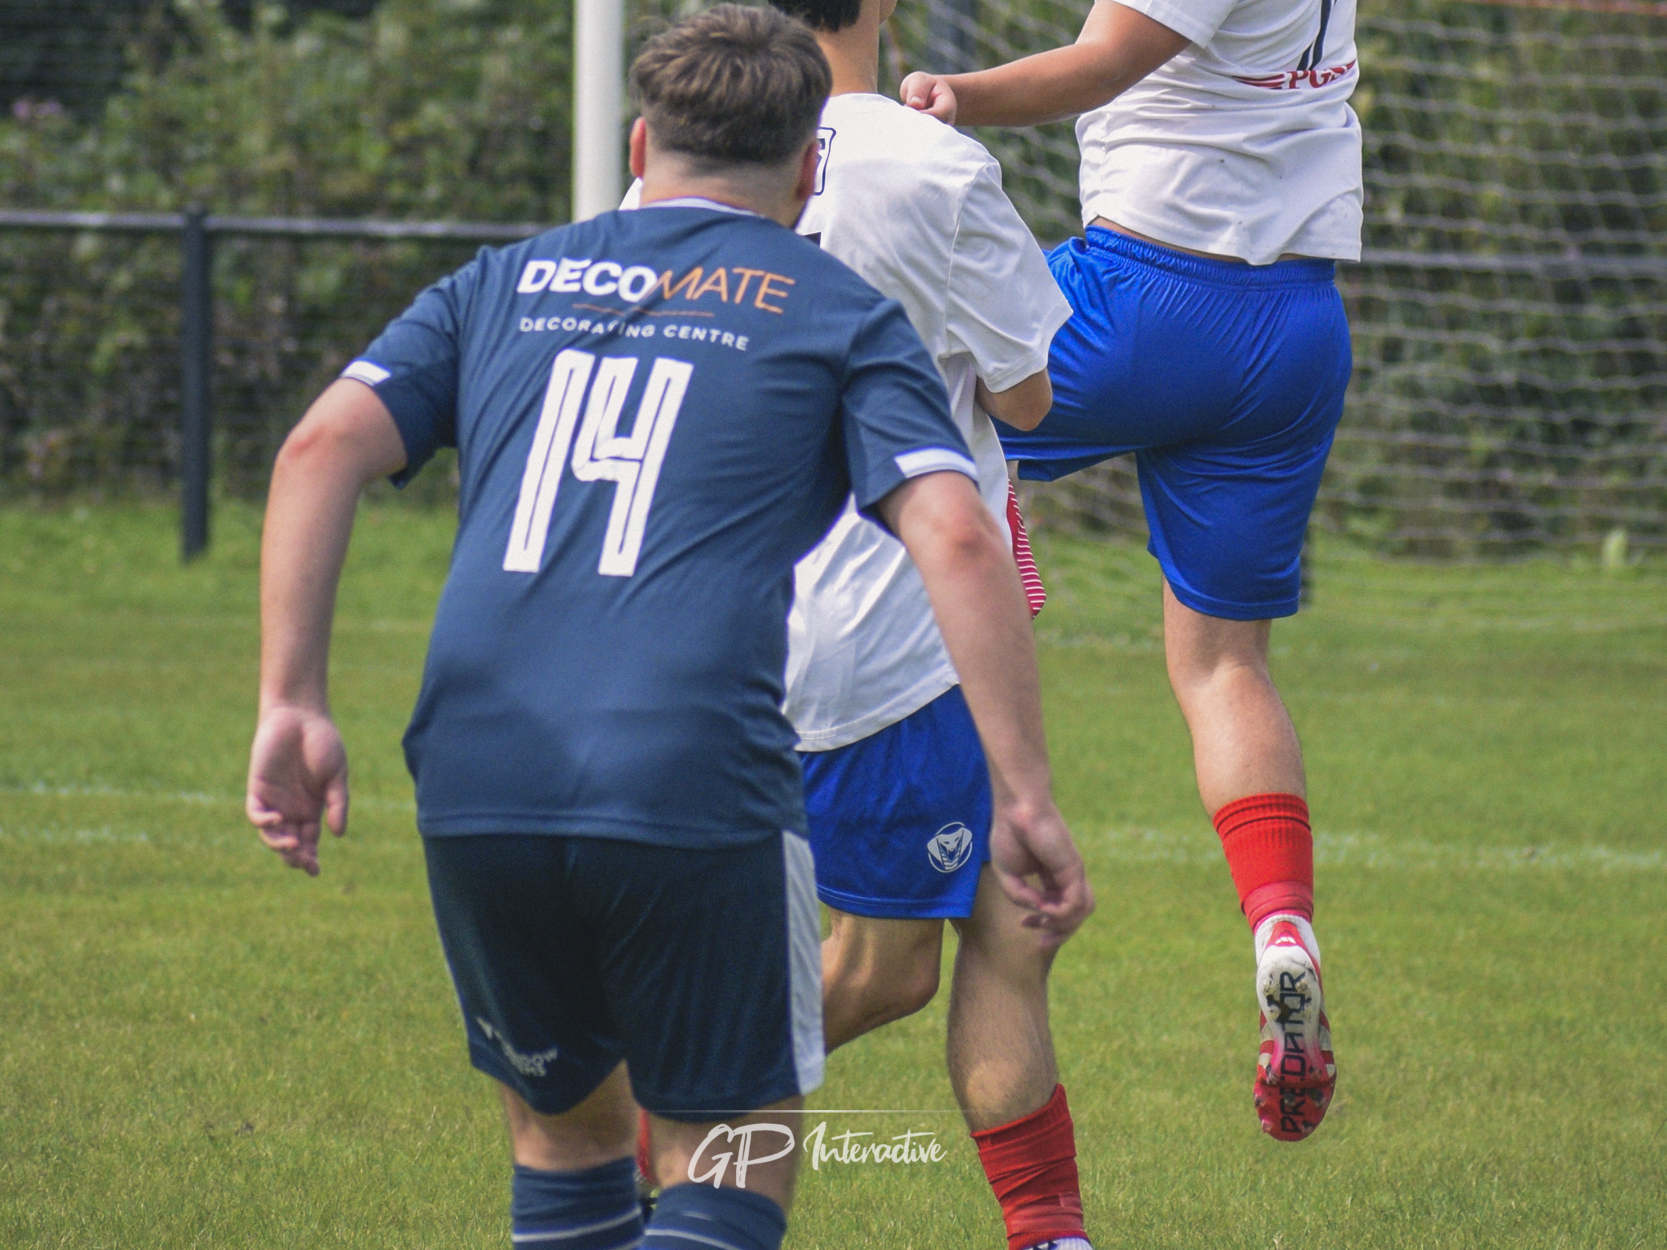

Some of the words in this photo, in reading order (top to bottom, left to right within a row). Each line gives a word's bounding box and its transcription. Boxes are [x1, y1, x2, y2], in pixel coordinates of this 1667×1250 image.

[516, 257, 796, 314] DECOMATE
[663, 324, 750, 351] CENTRE
[502, 348, 695, 577] 14
